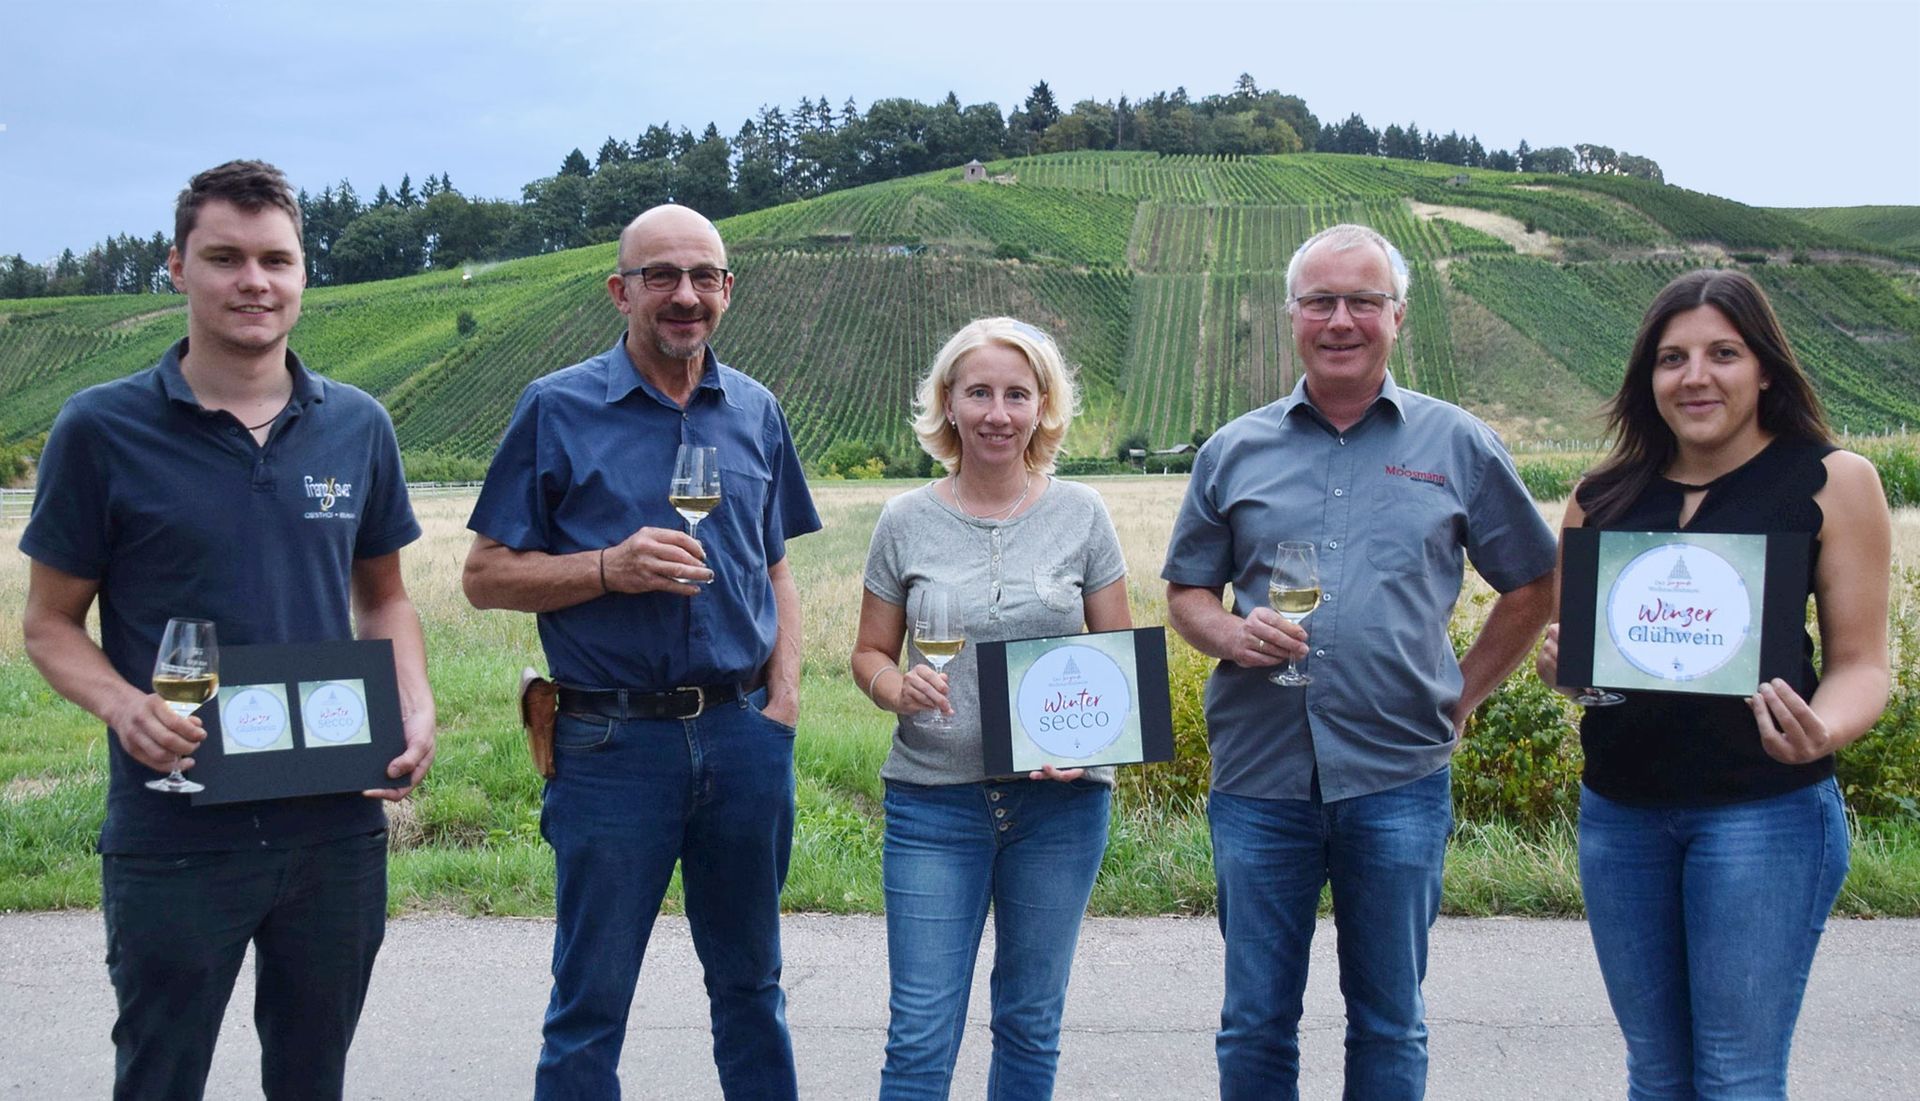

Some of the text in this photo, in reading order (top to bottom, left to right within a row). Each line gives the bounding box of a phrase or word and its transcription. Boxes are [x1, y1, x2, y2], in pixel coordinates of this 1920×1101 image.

[1385, 464, 1446, 485] Moosmann
[1638, 598, 1718, 627] Winzer
[1628, 625, 1724, 646] Glühwein
[1043, 688, 1102, 713] Winter
[1039, 711, 1109, 732] secco
